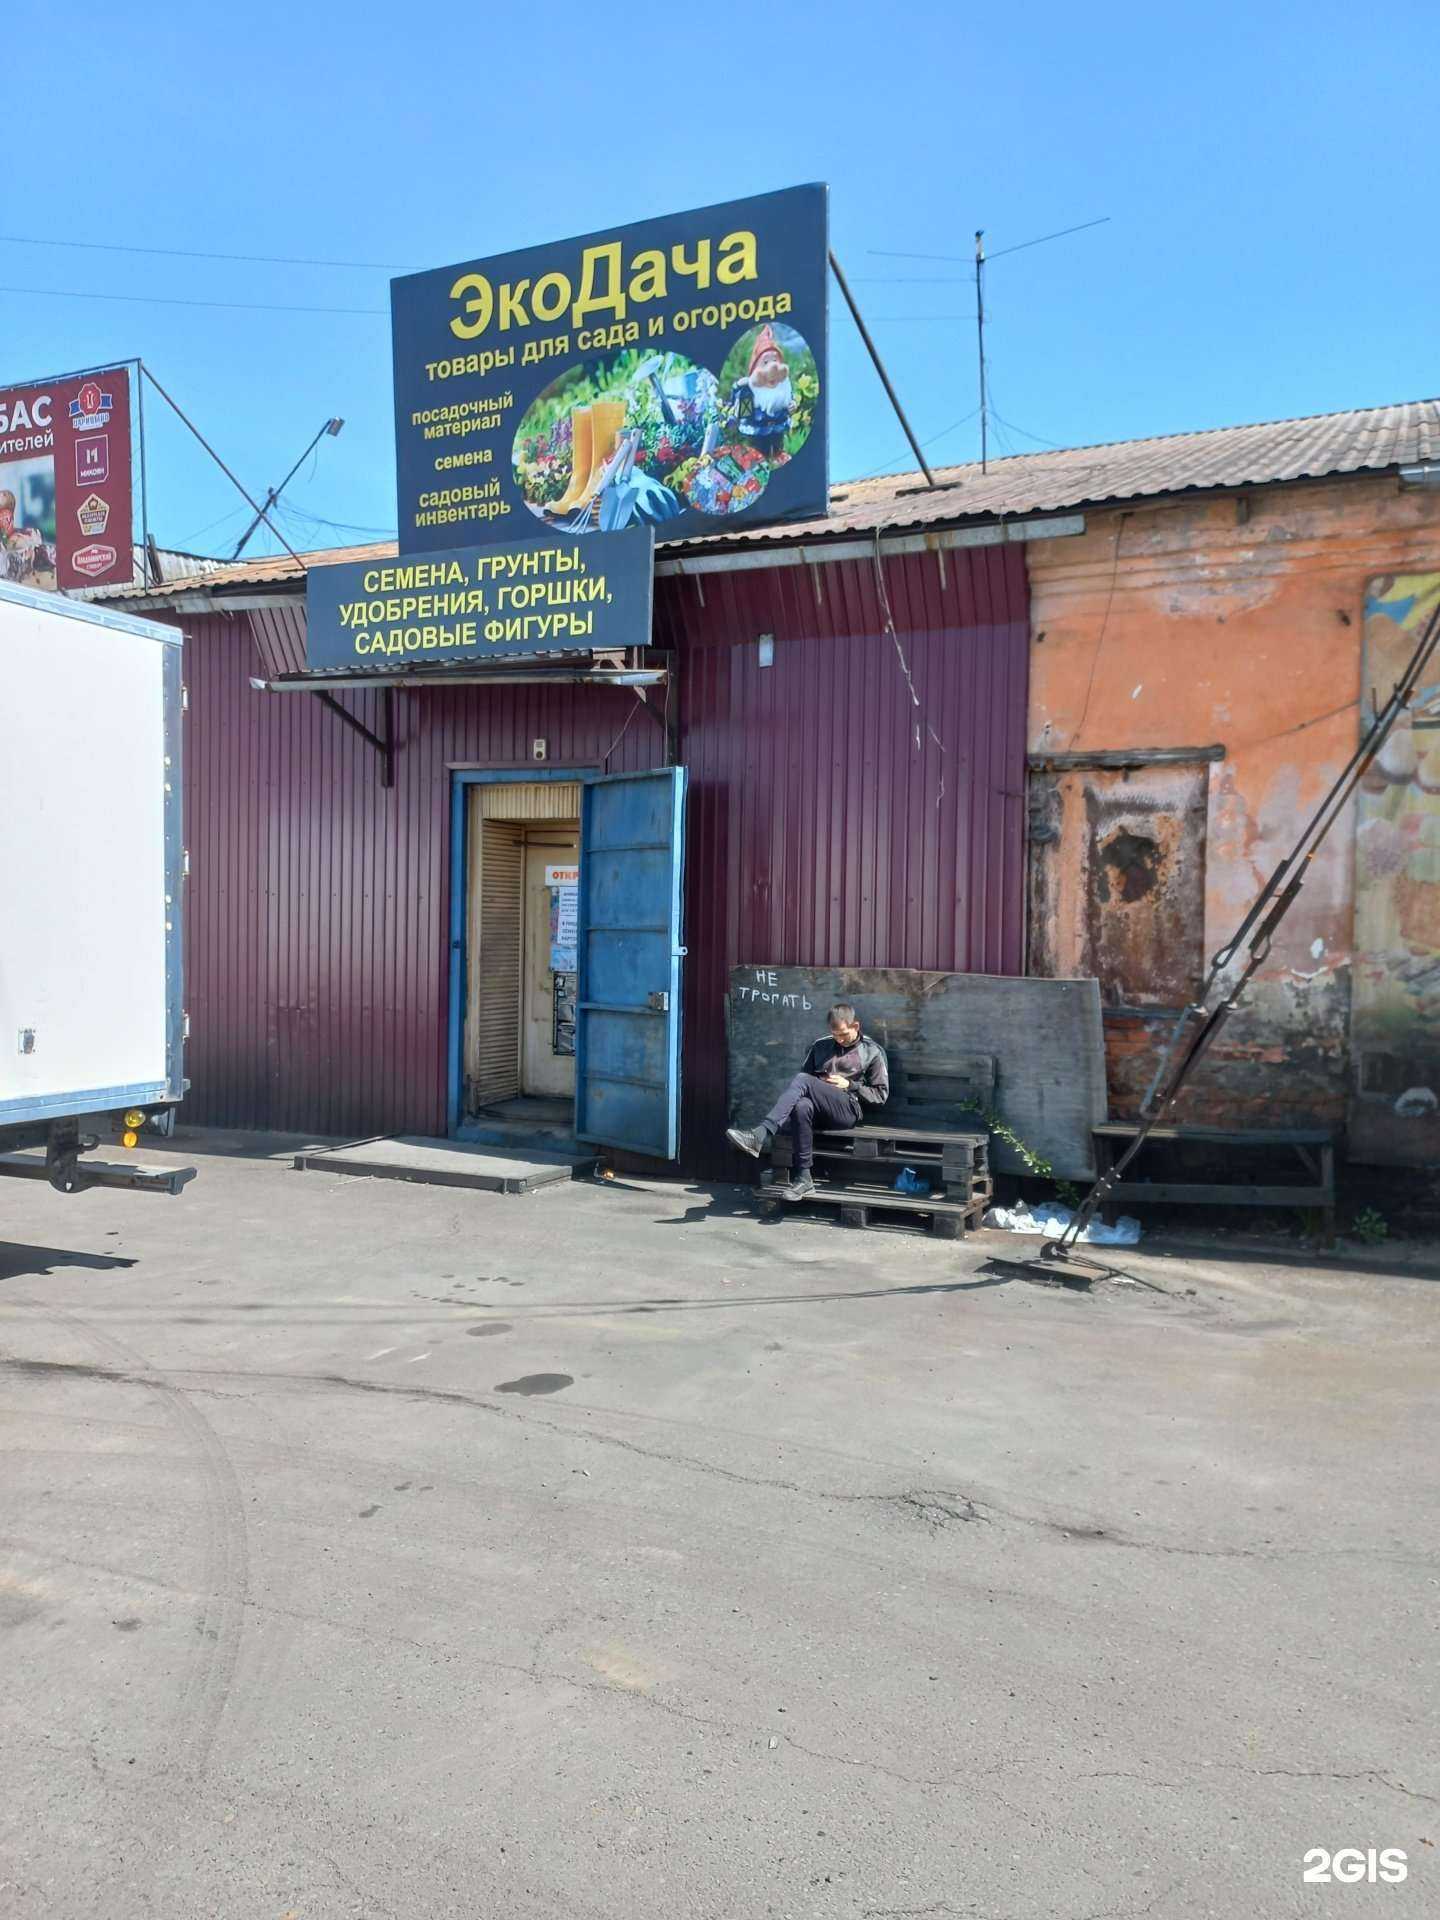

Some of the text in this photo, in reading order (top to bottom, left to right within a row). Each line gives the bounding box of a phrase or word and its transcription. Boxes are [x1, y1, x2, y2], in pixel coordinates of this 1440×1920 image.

[449, 230, 758, 339] ЭкоДача
[425, 292, 792, 381] товары для сада и огорода
[412, 390, 514, 426] посадочный
[424, 414, 501, 440] материал
[434, 448, 493, 471] семена
[419, 477, 501, 508] садовый
[415, 500, 511, 527] инвентарь
[364, 547, 586, 593] СЕМЕНА, ГРУНТЫ,
[339, 576, 613, 629] УДОБРЕНИЯ, ГОРШКИ,
[355, 611, 593, 655] САДОВЫЕ ФИГУРЫ
[756, 970, 778, 986] НЕ
[739, 987, 812, 1010] ТРОГАТЬ
